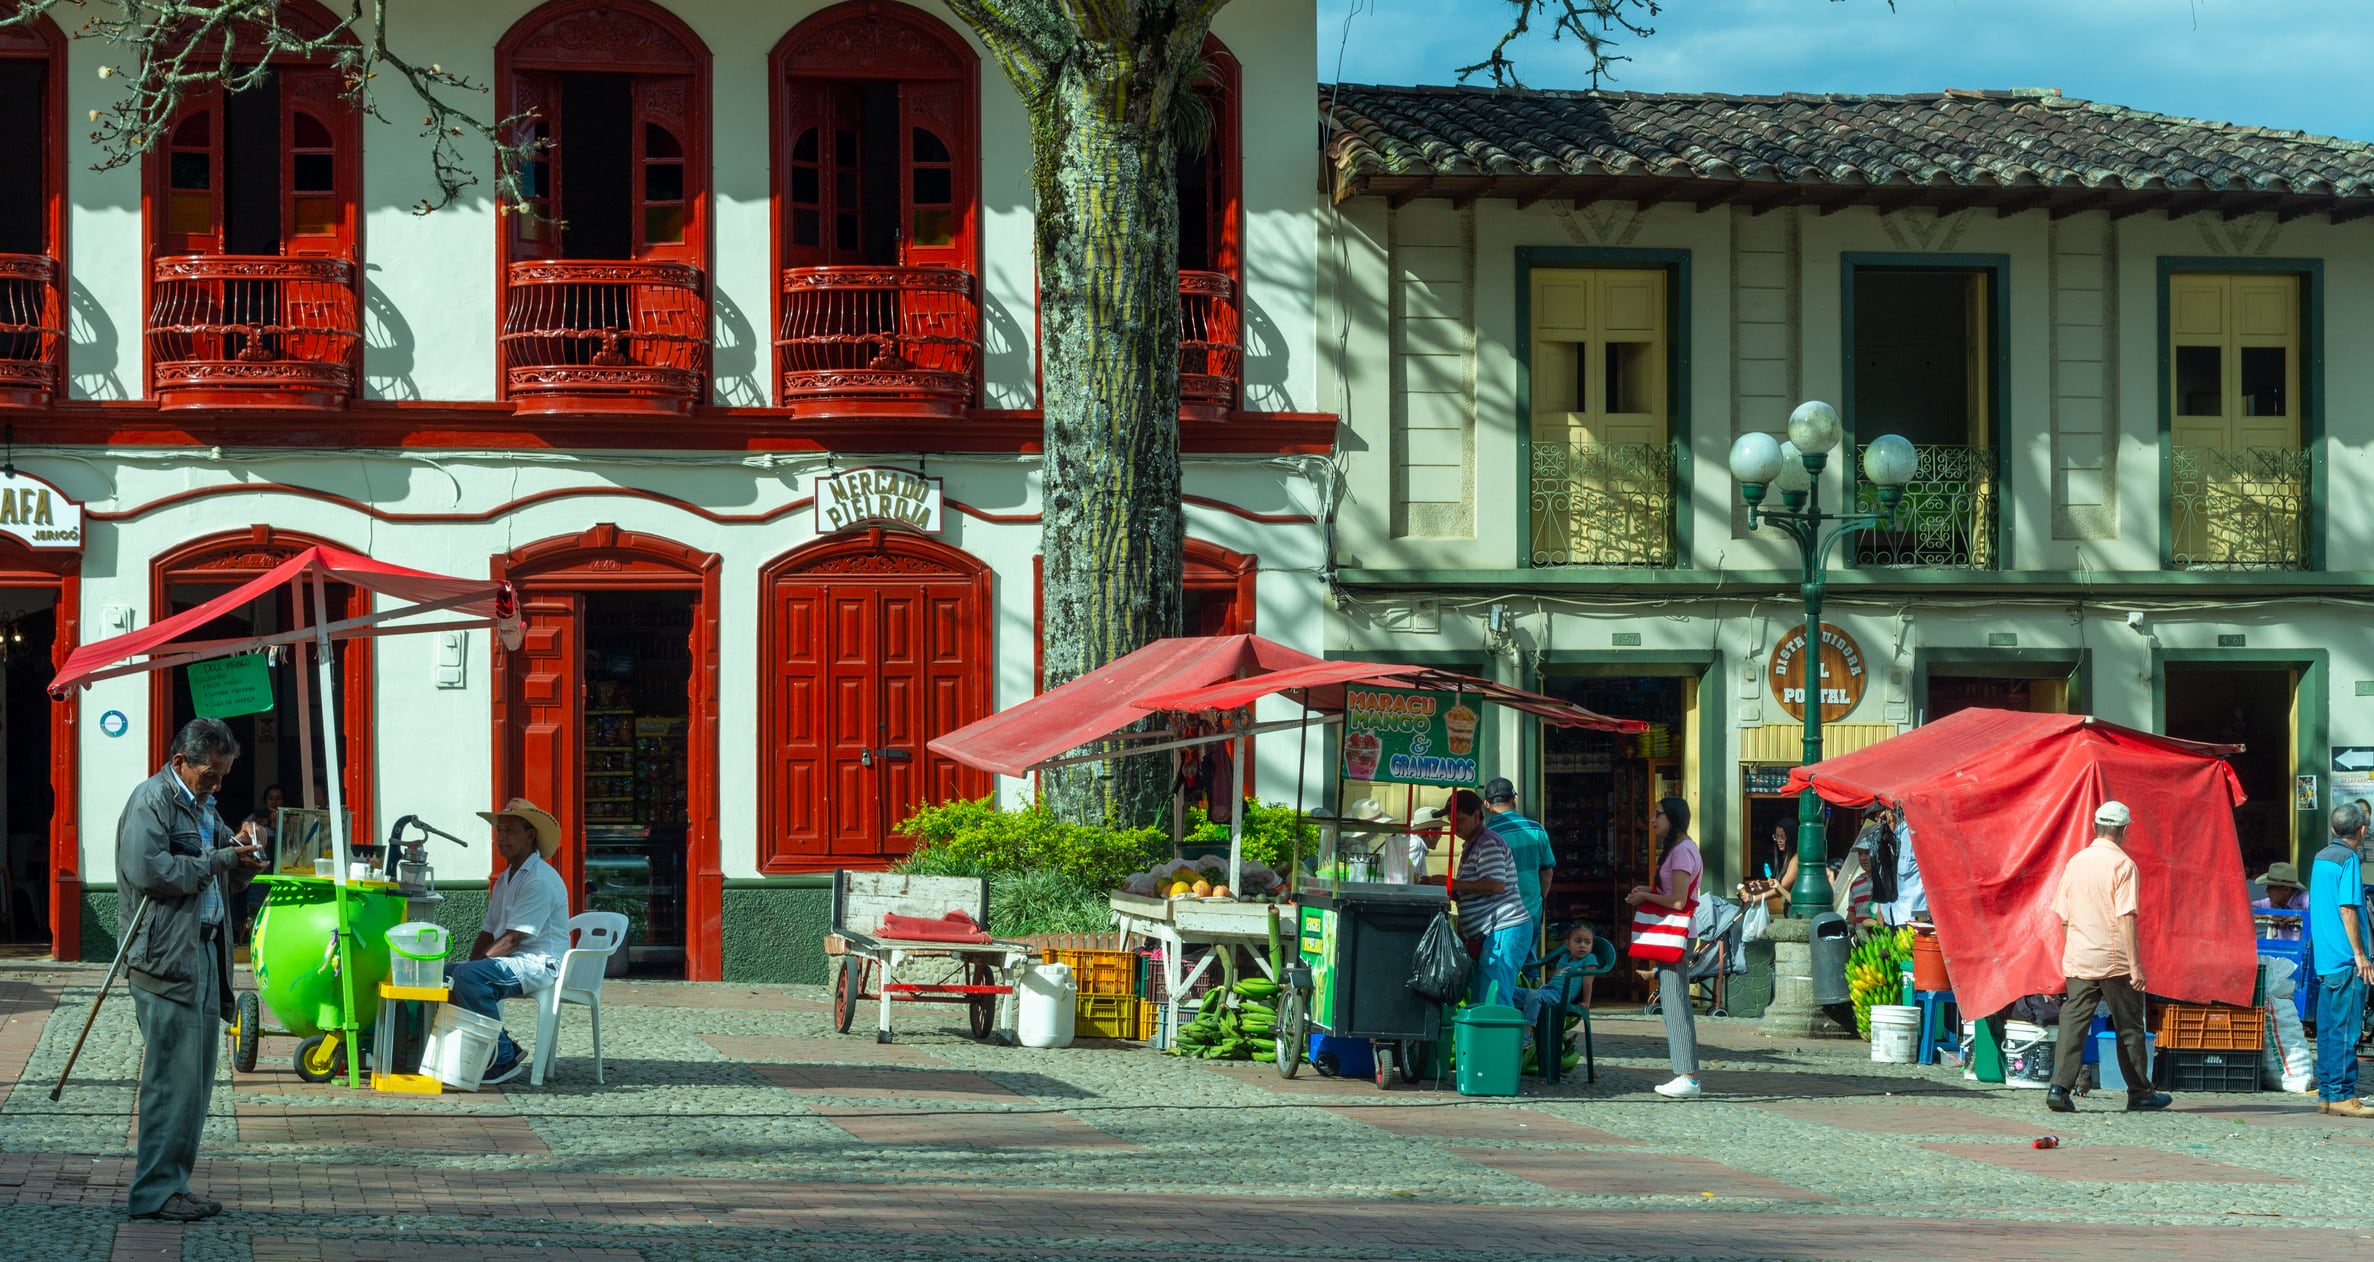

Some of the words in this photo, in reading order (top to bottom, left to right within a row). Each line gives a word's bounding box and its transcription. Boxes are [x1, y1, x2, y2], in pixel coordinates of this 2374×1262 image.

[829, 471, 929, 505] MERCADO
[826, 495, 932, 531] PIELROJA
[1775, 631, 1862, 676] DISTRUIDORA
[1348, 691, 1436, 716] MARACU
[1783, 688, 1850, 704] POTAL
[1351, 710, 1431, 734] MANGO
[1410, 734, 1431, 756] &
[1390, 753, 1475, 782] GRANIZADOS
